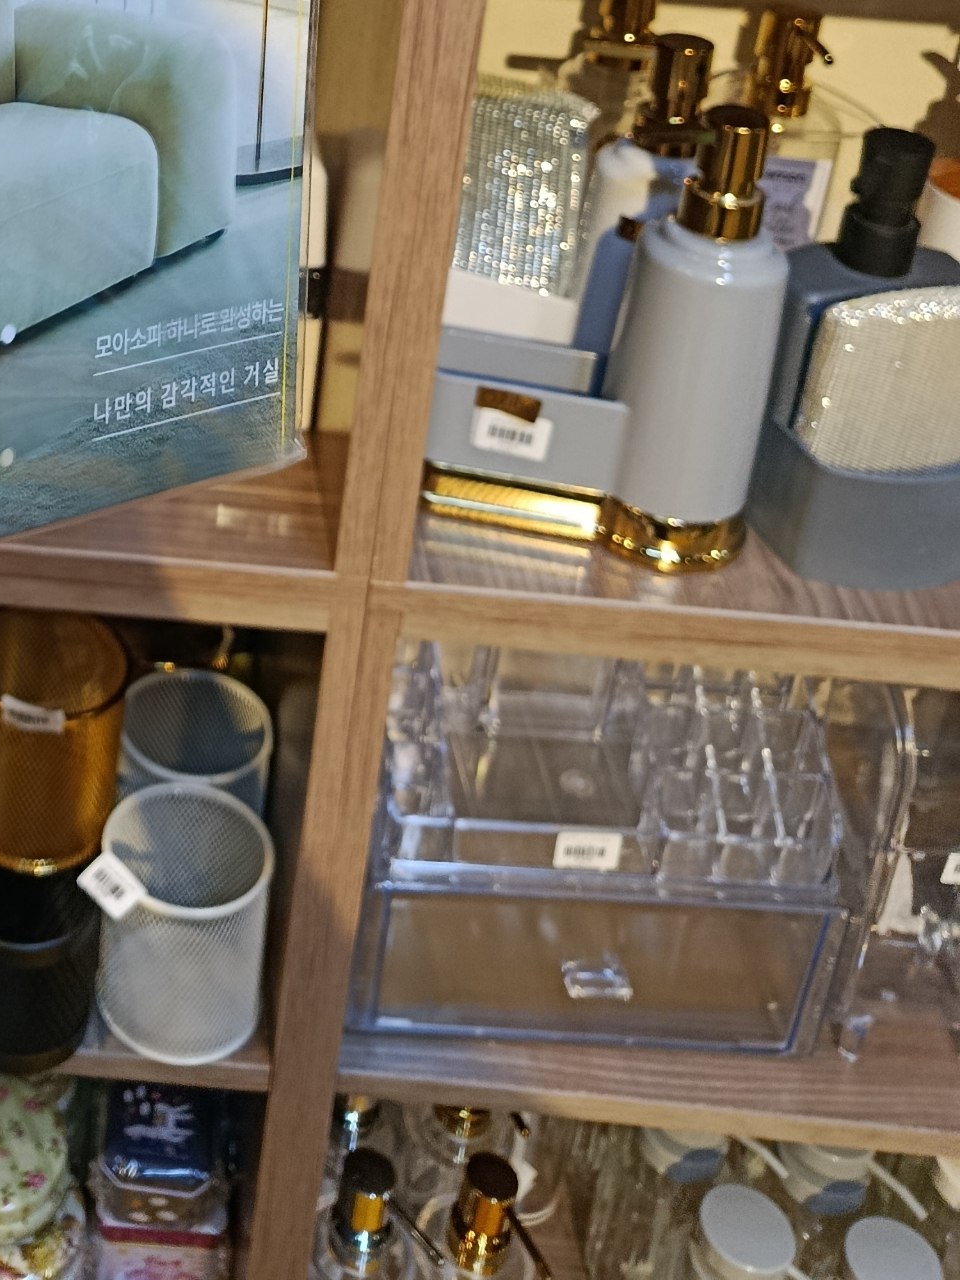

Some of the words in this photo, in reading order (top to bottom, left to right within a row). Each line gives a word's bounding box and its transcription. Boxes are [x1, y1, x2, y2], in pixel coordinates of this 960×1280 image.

[93, 387, 152, 425] 나만의
[161, 367, 236, 410] 감각적인
[243, 357, 280, 388] 거실
